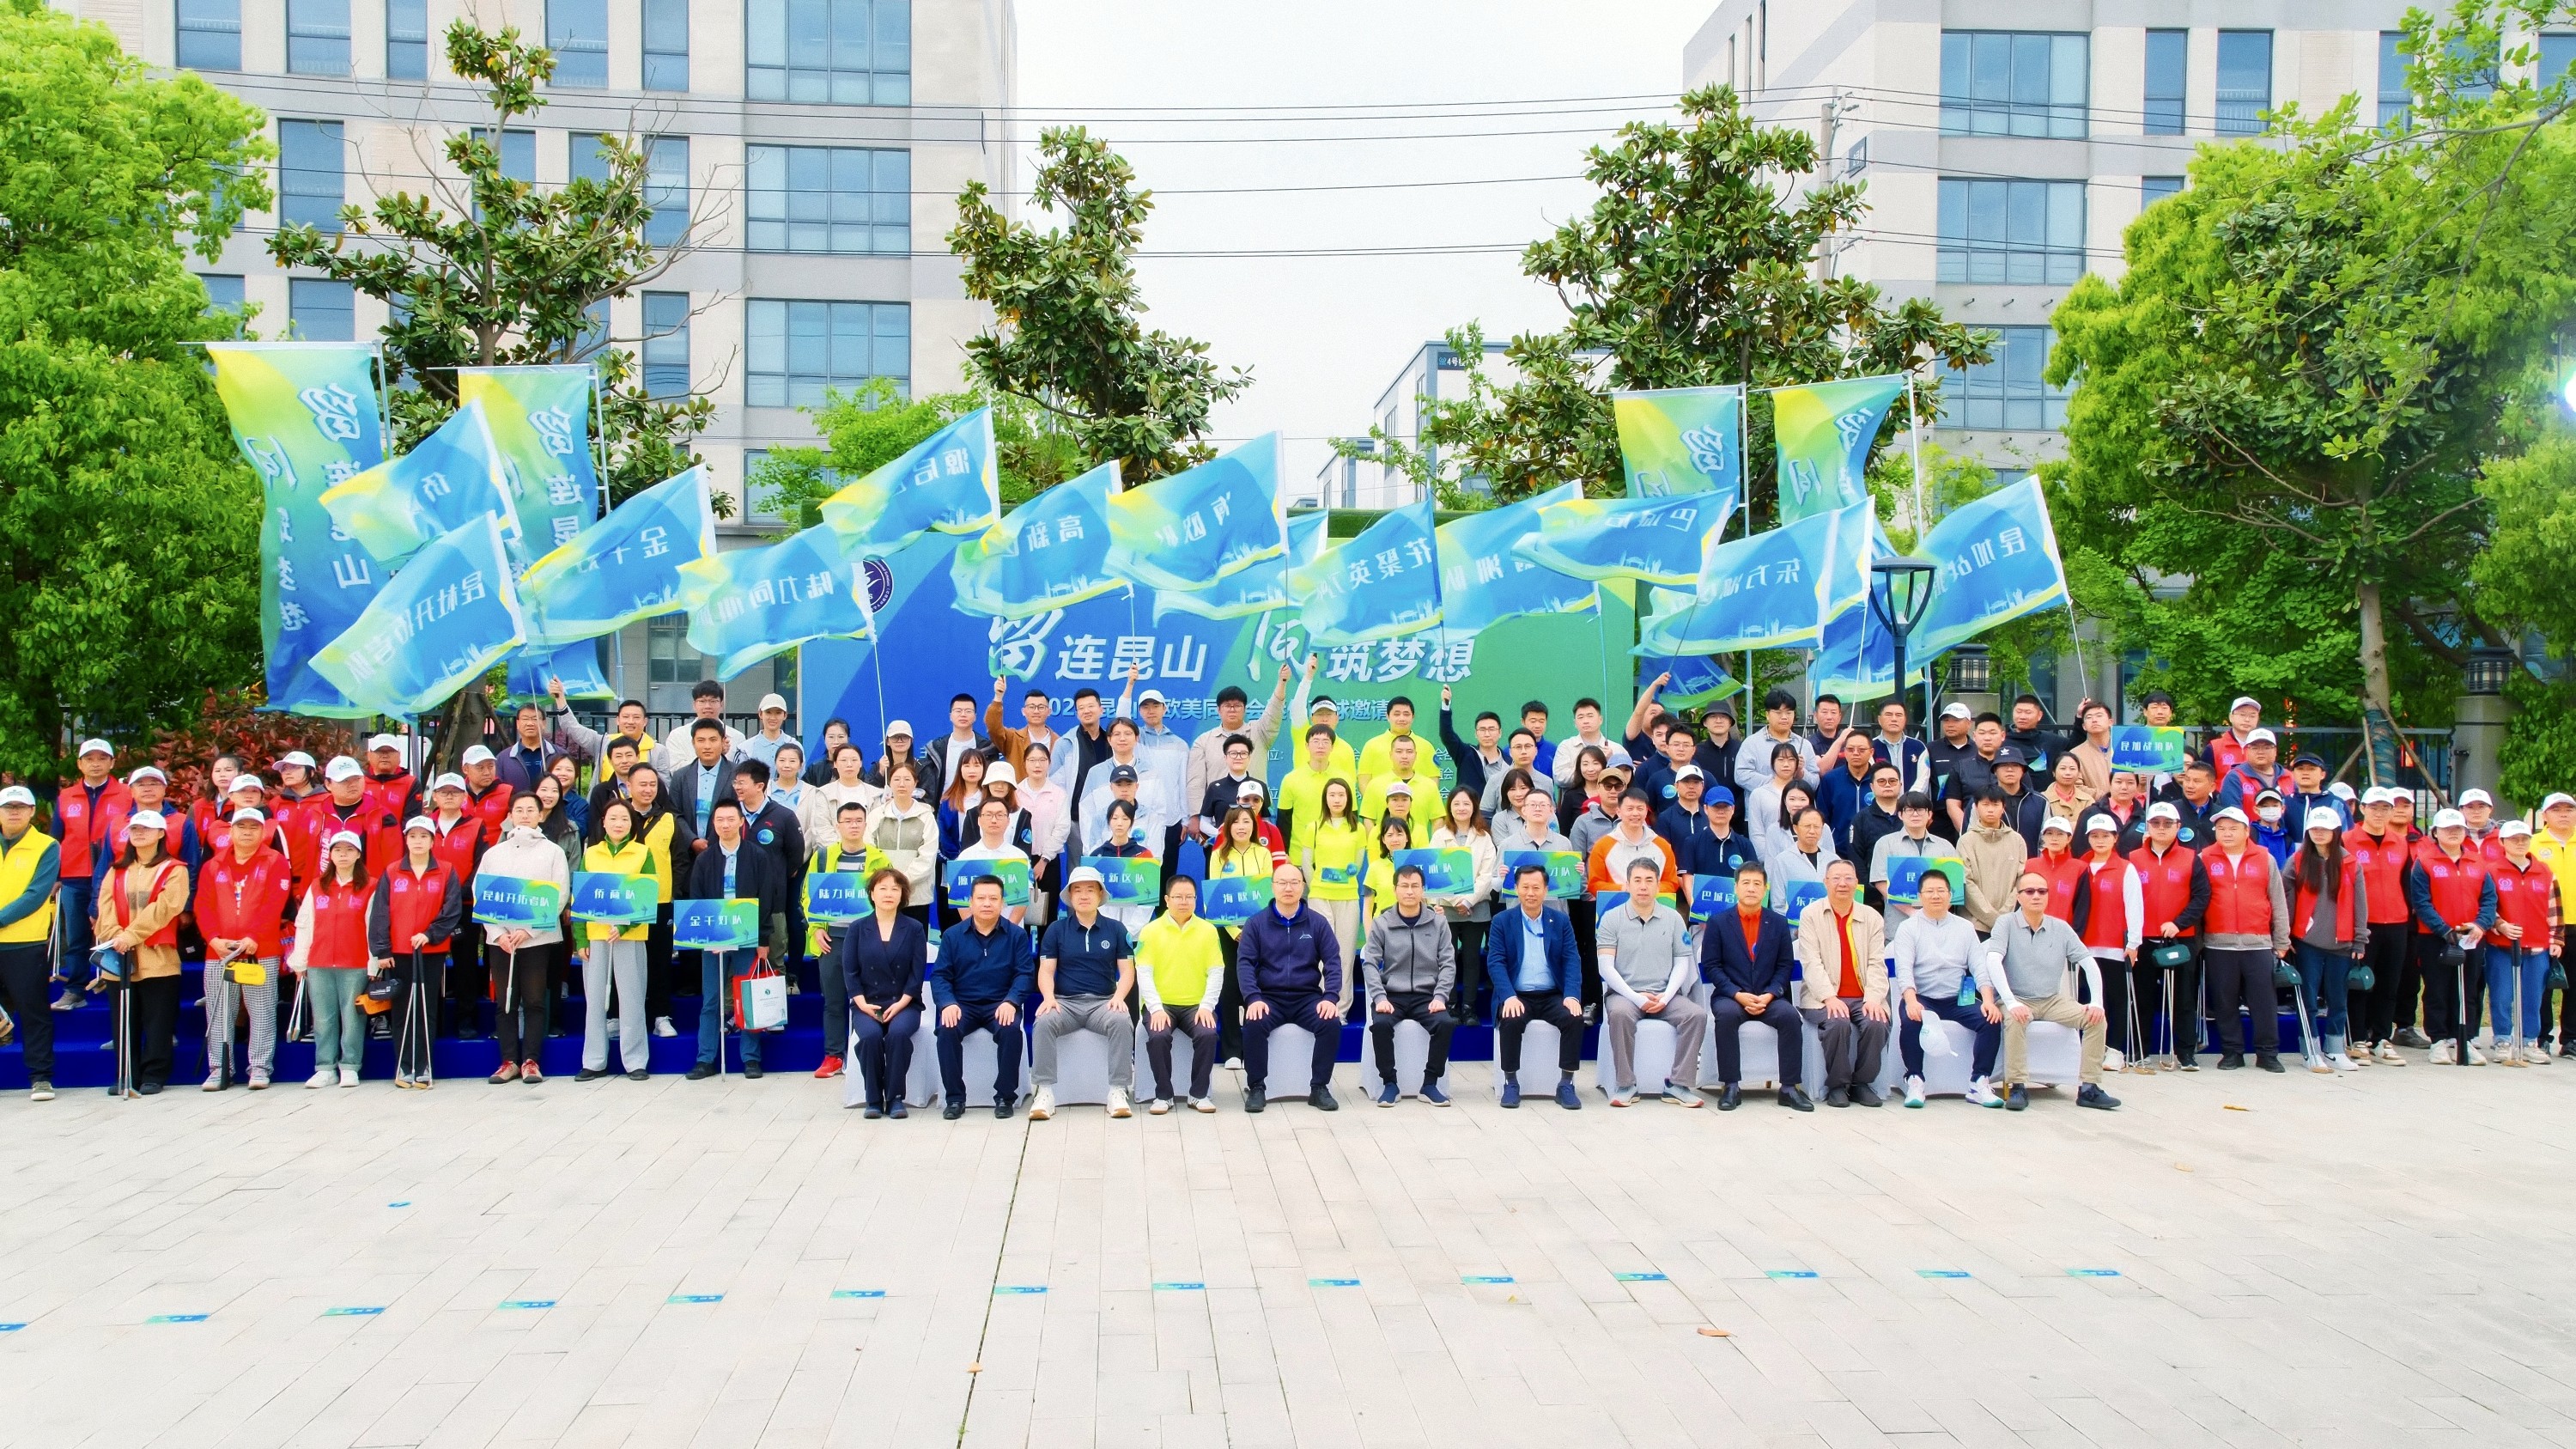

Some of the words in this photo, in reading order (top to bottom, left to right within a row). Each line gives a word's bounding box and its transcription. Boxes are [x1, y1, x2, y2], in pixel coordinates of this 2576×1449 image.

[988, 608, 1207, 682] 留连昆山
[818, 888, 869, 899] 陆力同心
